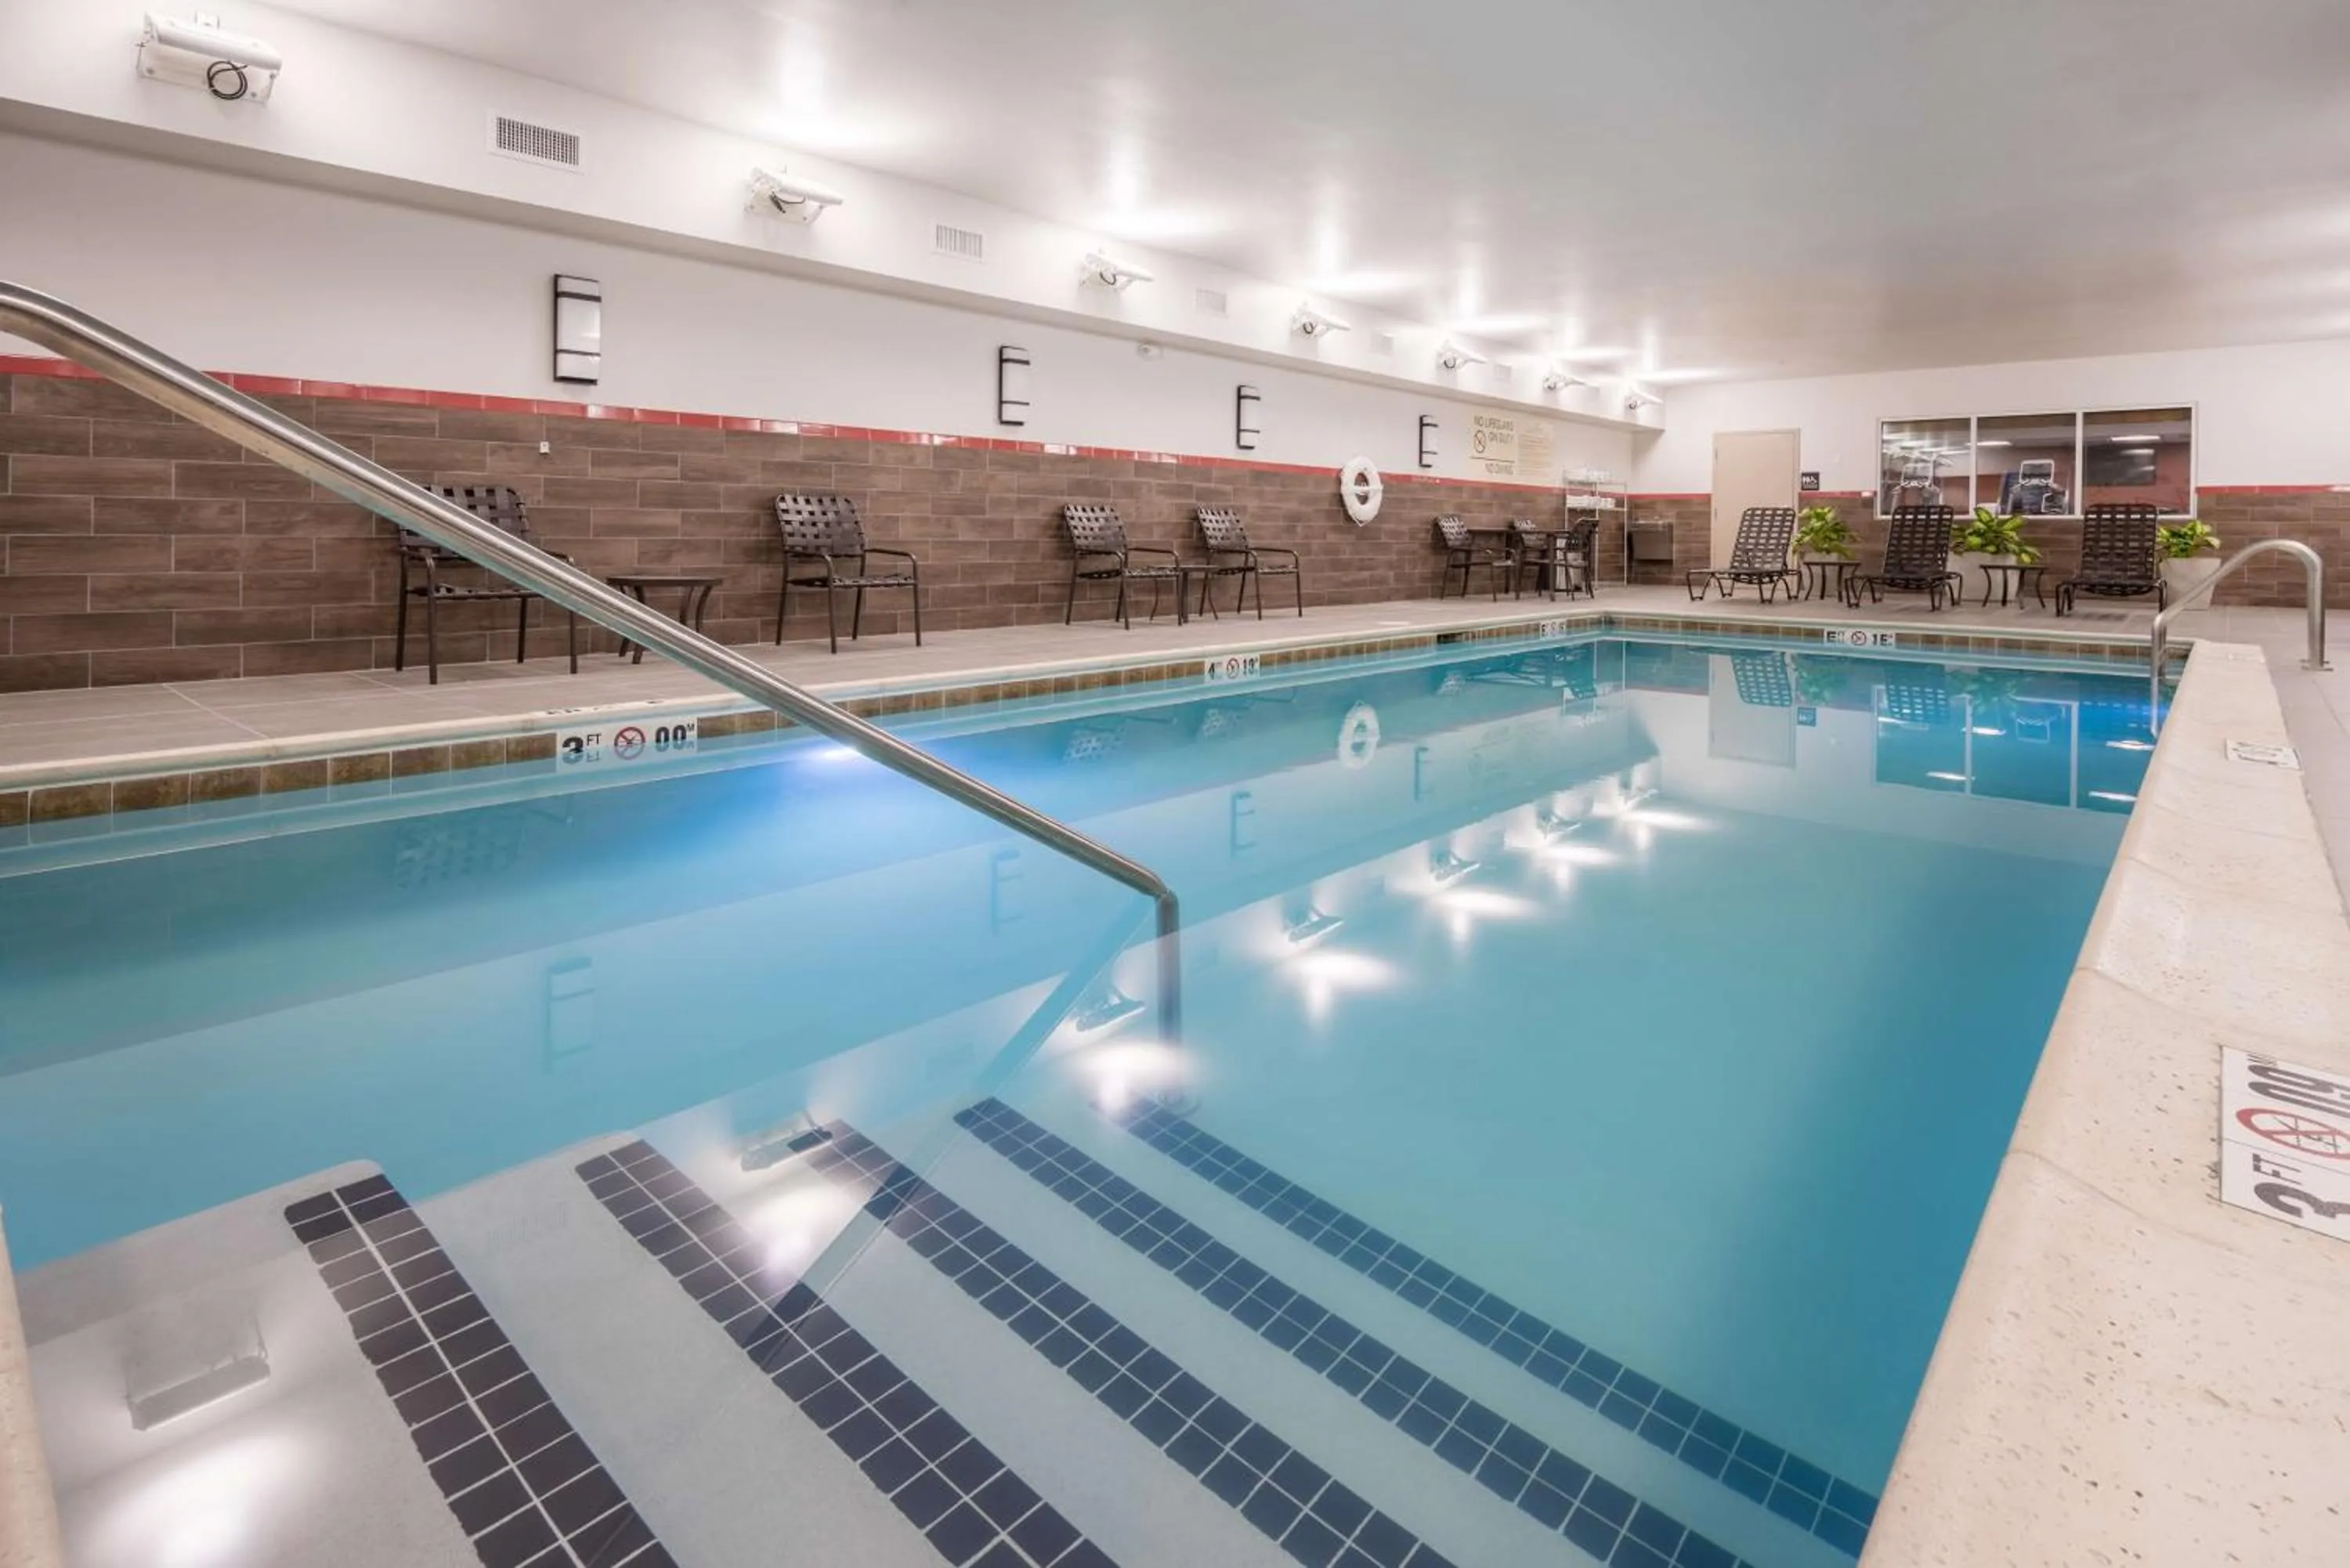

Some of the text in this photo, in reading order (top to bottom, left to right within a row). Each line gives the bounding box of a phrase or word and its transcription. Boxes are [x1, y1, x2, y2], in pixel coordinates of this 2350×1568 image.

[1473, 414, 1484, 427] NO
[587, 733, 602, 746] FT
[2253, 1153, 2302, 1185] FT
